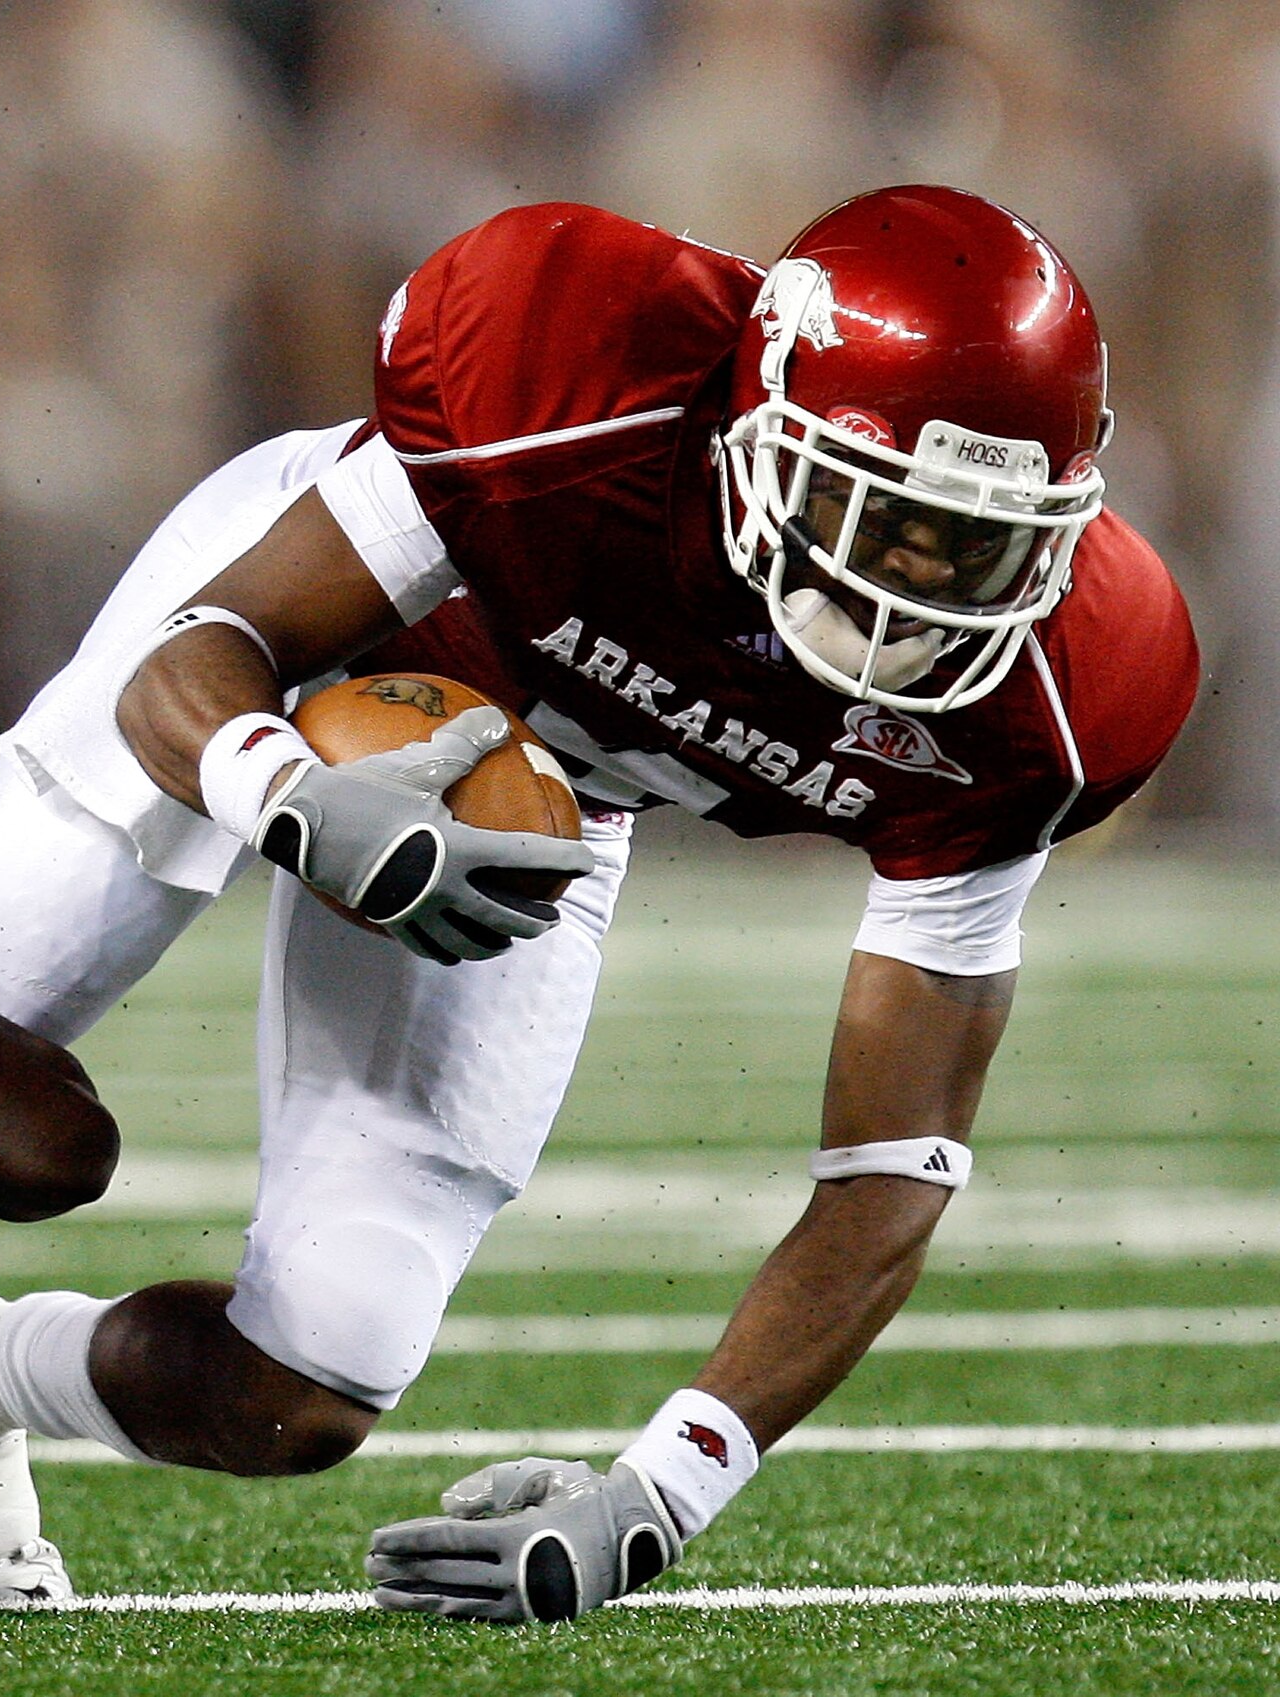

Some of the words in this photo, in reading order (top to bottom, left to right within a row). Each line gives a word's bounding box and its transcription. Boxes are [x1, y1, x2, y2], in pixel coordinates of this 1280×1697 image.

[957, 439, 1009, 468] HOGS
[530, 616, 876, 821] ARKANSAS
[873, 722, 920, 760] SEC
